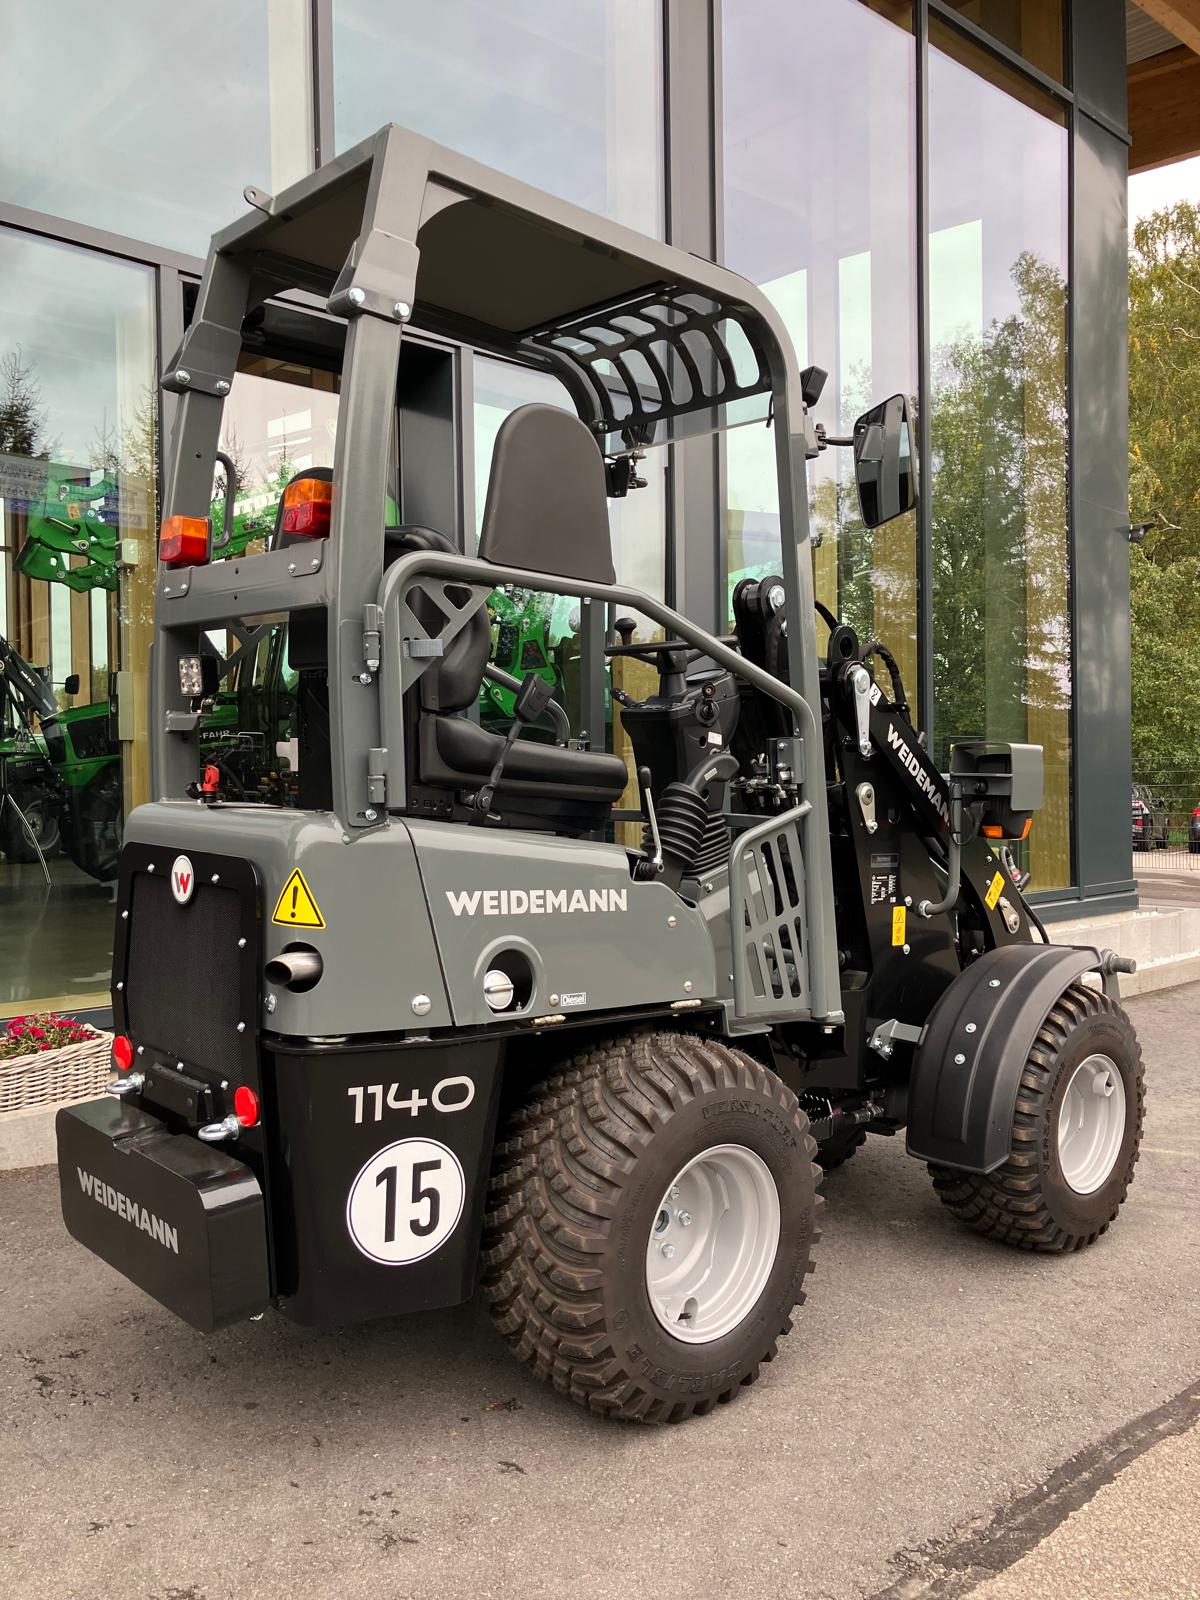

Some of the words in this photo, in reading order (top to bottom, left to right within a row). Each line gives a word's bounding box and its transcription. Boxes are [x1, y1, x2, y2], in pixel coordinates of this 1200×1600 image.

[199, 729, 230, 740] -FAHR
[886, 722, 951, 828] WEIDEMAN
[445, 888, 628, 916] WEIDEMANN
[562, 993, 585, 1006] Diesel
[347, 1075, 476, 1124] 1140
[76, 1165, 180, 1255] WEIDEMANN
[375, 1158, 442, 1244] 15
